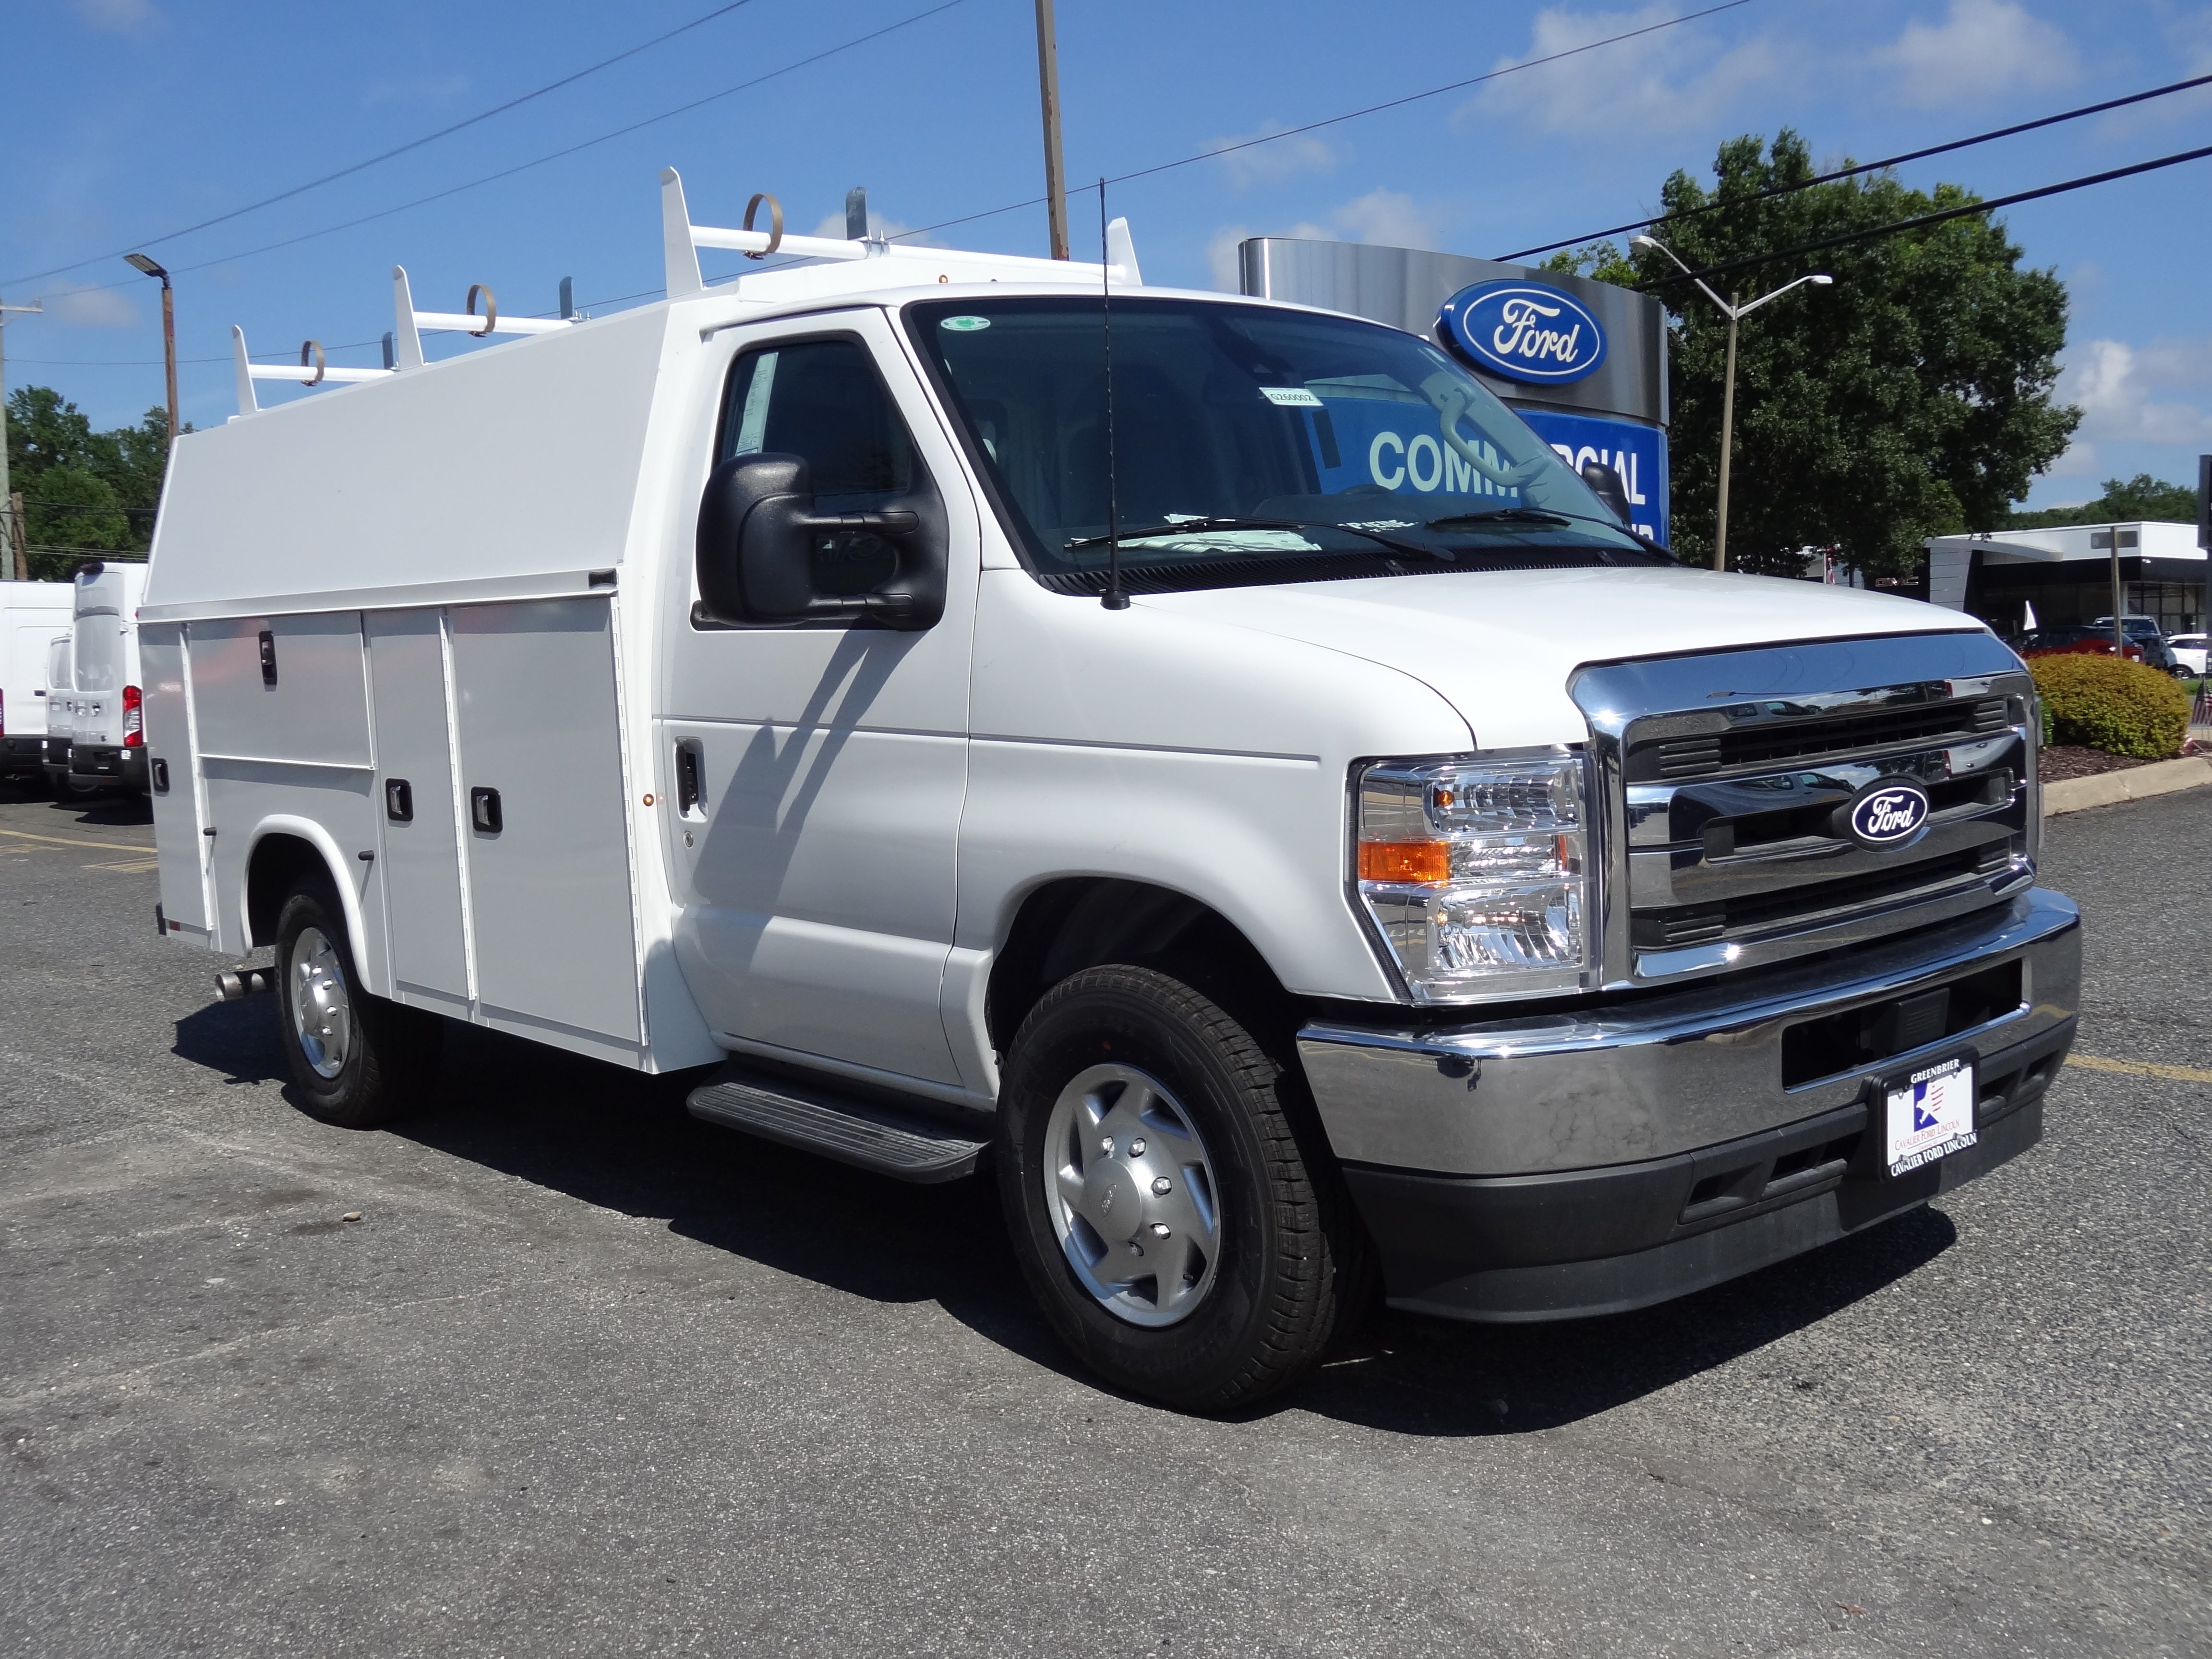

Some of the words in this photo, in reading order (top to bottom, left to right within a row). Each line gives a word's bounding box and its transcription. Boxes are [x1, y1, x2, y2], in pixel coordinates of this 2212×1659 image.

[1493, 299, 1580, 362] Ford
[1868, 795, 1915, 833] Ford
[1911, 1058, 1960, 1084] GREENBRIER
[1895, 1134, 1920, 1151] CAVALIER
[1921, 1129, 1936, 1141] FORD
[1937, 1119, 1960, 1134] LINCOLN
[1923, 1145, 1944, 1163] FORD
[1944, 1132, 1978, 1154] LINCOLN
